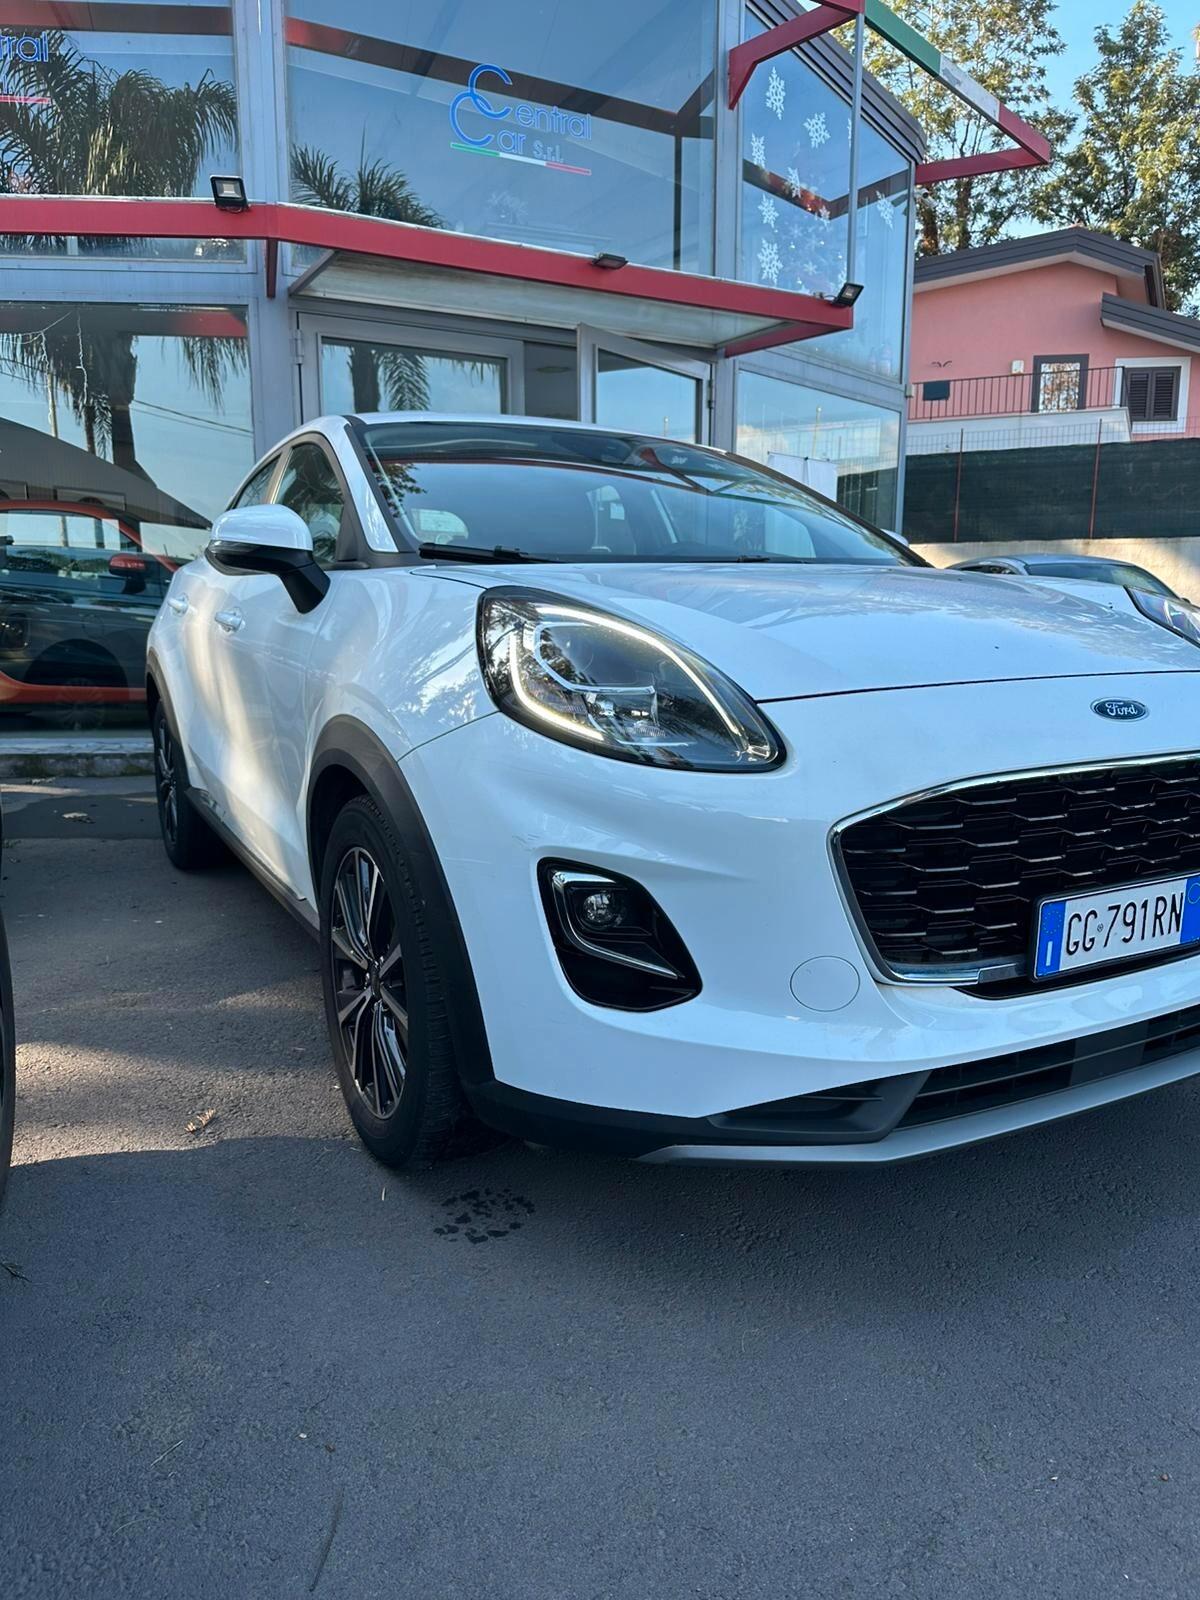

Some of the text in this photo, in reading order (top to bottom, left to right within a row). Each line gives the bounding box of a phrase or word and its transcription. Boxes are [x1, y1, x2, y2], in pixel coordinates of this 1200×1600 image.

[450, 90, 526, 155] Car
[468, 63, 592, 141] Central
[1105, 701, 1138, 716] Ford
